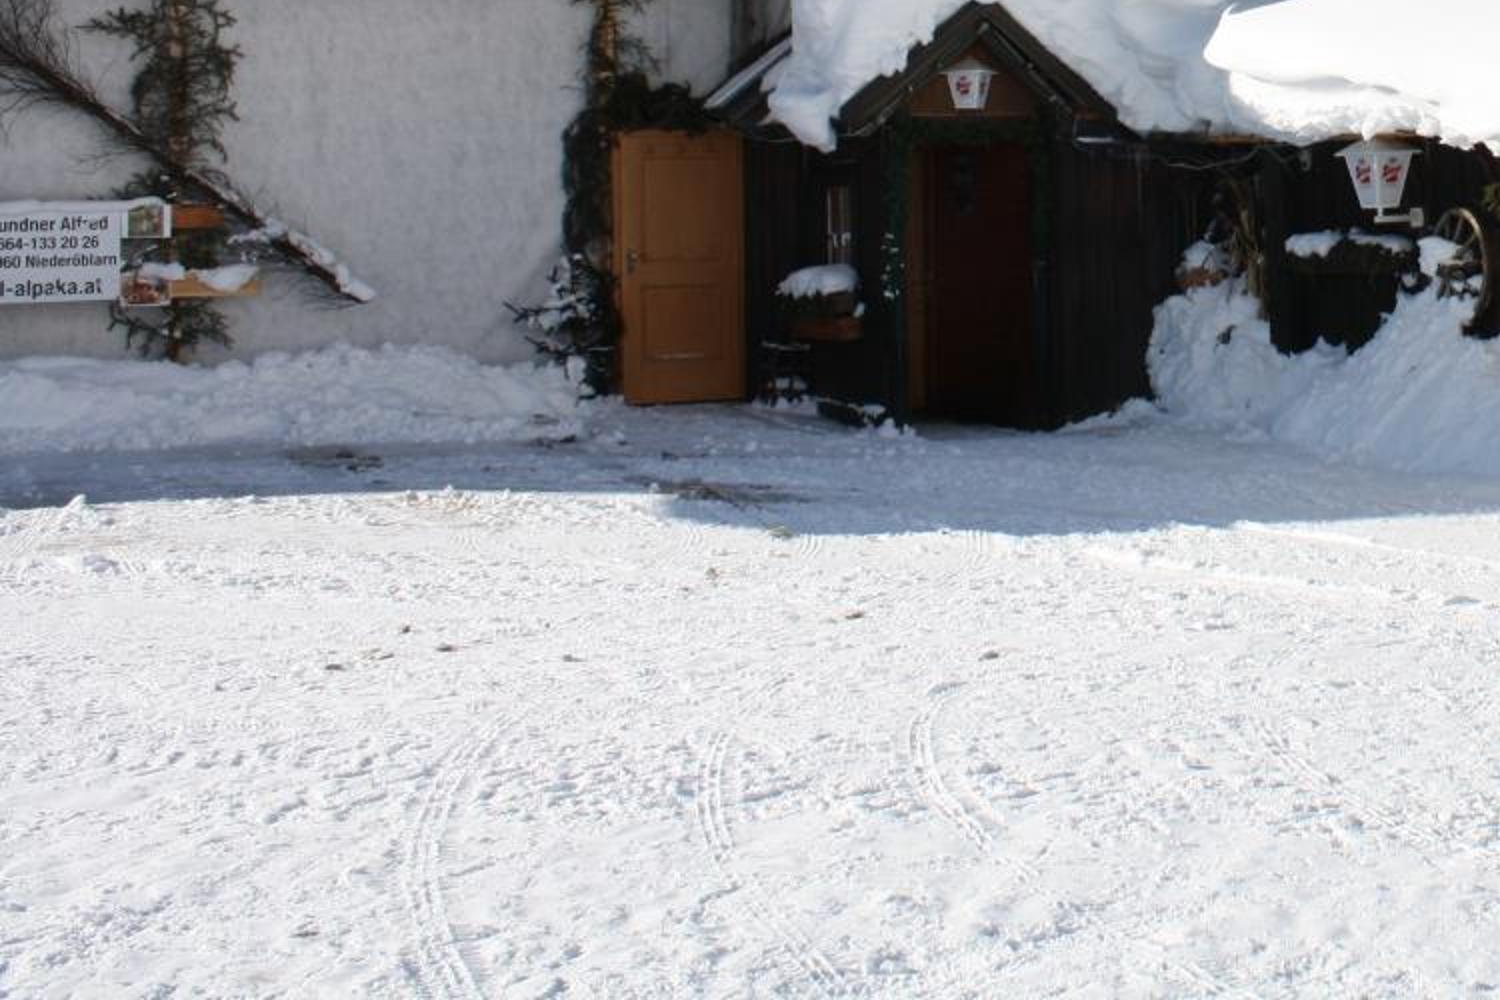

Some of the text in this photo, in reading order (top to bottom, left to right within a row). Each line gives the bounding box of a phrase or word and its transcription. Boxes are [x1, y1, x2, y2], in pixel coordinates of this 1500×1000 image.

[60, 215, 110, 231] Alfred
[60, 235, 79, 249] 20
[81, 235, 100, 249] 26
[0, 253, 118, 269] 60 Niederöblarn
